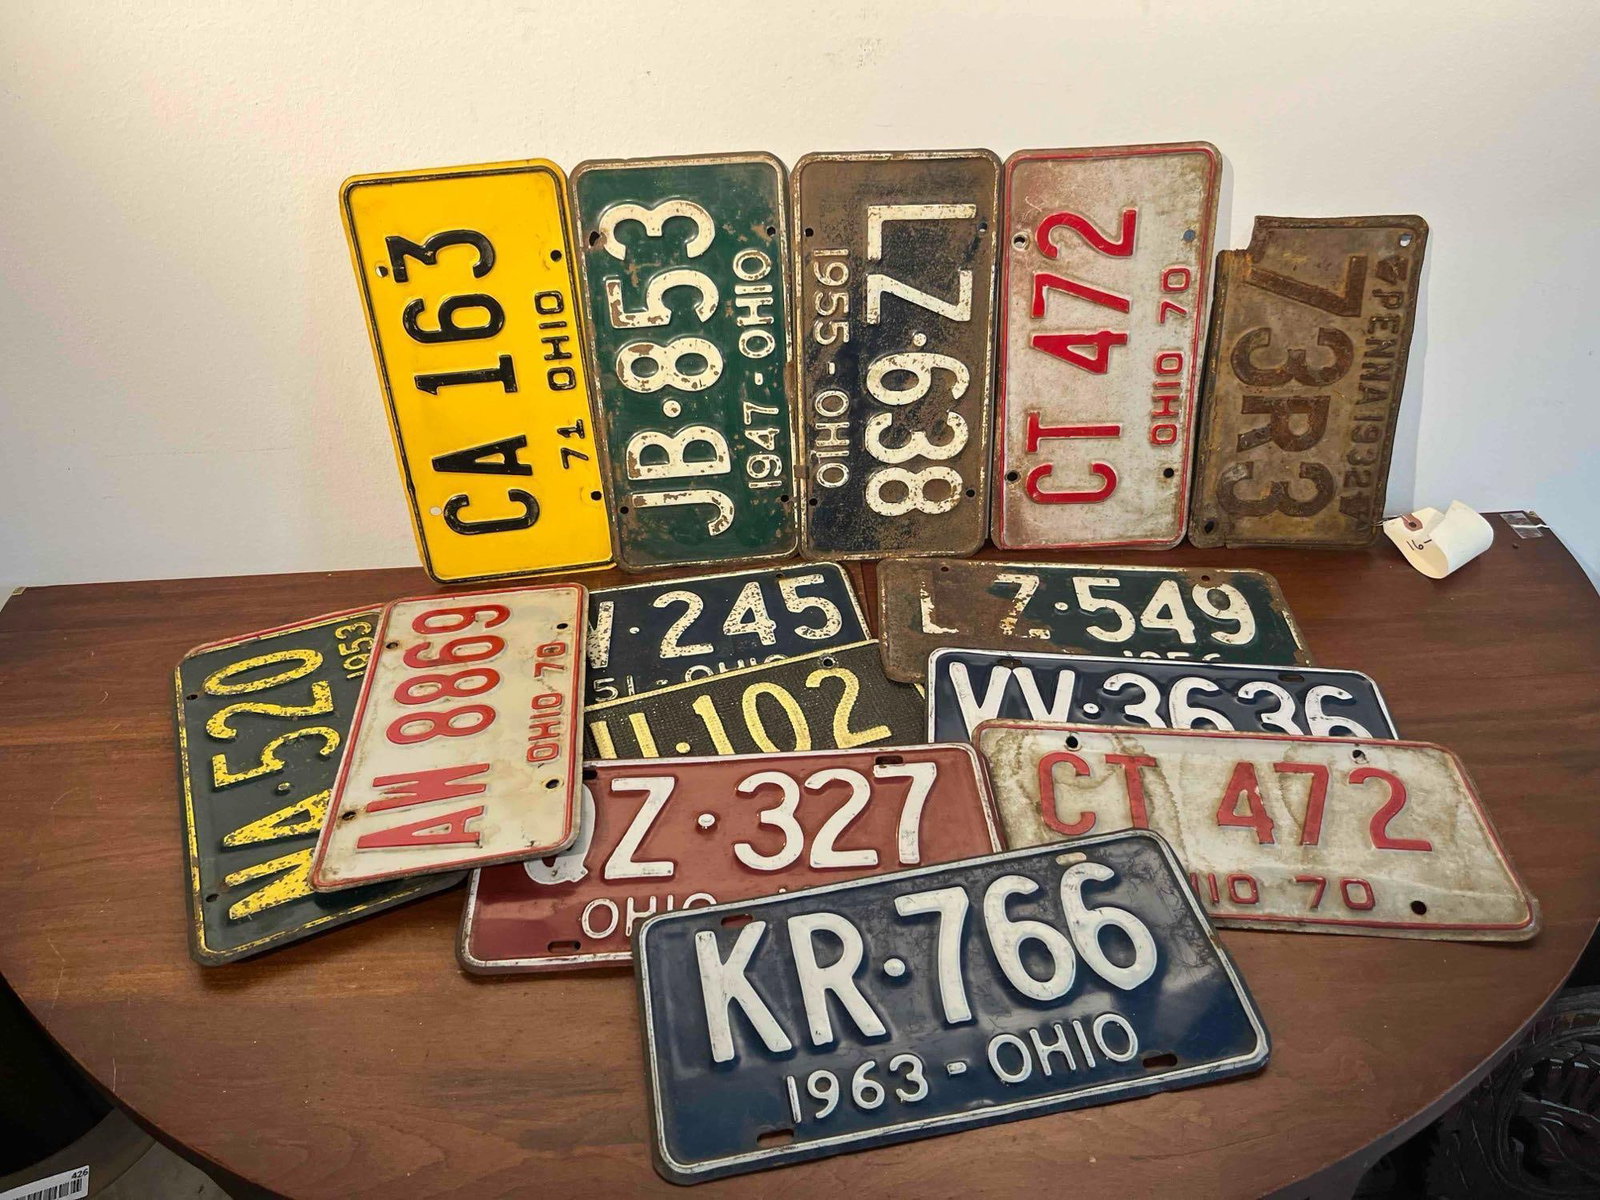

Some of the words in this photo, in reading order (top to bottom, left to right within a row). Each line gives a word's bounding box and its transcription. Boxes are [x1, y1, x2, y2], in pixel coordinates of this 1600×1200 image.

[385, 229, 519, 396] 163
[733, 249, 776, 359] OHIO
[813, 247, 850, 346] 1955
[1031, 205, 1138, 375] 472
[1159, 266, 1191, 325] 70
[534, 290, 577, 391] OHIO
[1216, 255, 1368, 518] 73R3
[556, 418, 590, 469] 71
[744, 401, 783, 488] 1947
[810, 389, 850, 489] OHIO
[1150, 350, 1185, 447] OHIO
[432, 435, 540, 536] CA
[1026, 410, 1121, 505] CT
[386, 604, 512, 746] 8869
[533, 641, 567, 678] 70
[526, 692, 563, 763] OHIO
[357, 763, 490, 850] AW
[1037, 750, 1158, 836] CT
[1215, 761, 1432, 852] 472
[1295, 874, 1376, 911] 70
[785, 1053, 929, 1124] 1963
[987, 1012, 1138, 1085] OHIO
